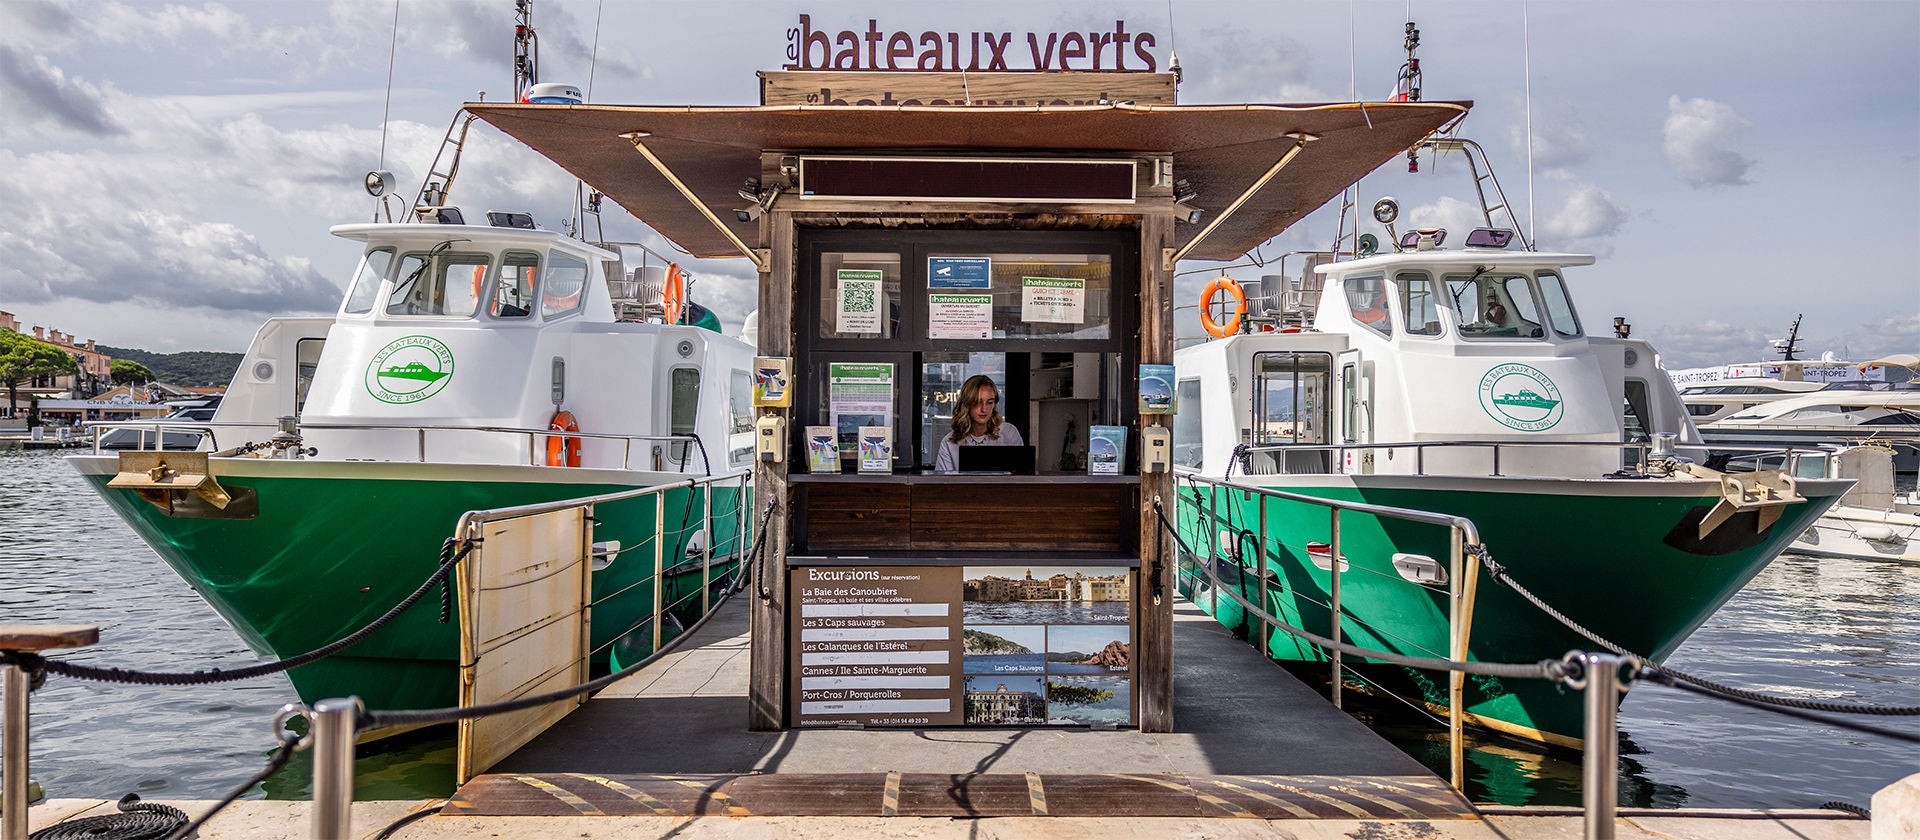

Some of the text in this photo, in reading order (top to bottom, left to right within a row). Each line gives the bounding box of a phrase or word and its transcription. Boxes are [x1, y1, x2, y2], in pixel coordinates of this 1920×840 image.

[782, 14, 1156, 72] les bateaux verts
[374, 338, 451, 364] LES BATEAUX VERTS
[1482, 365, 1556, 392] LES BATEAUX VERTS
[1677, 371, 1718, 383] SAINT-TROPEZ
[377, 390, 427, 401] SINCE 1961
[1504, 418, 1553, 429] SINCE 1961
[809, 568, 880, 581] Excursions
[802, 587, 898, 596] La Baie des Canoubiers
[802, 618, 886, 628] Les 3 Caps sauvages
[802, 641, 908, 653] Les Calanques de l'Estérel
[802, 666, 834, 675] Cannes
[840, 666, 851, 674] Ile
[853, 665, 927, 676] Sainte-Marguerite
[802, 691, 843, 700] Port-Cros
[849, 690, 902, 700] Porquerolles
